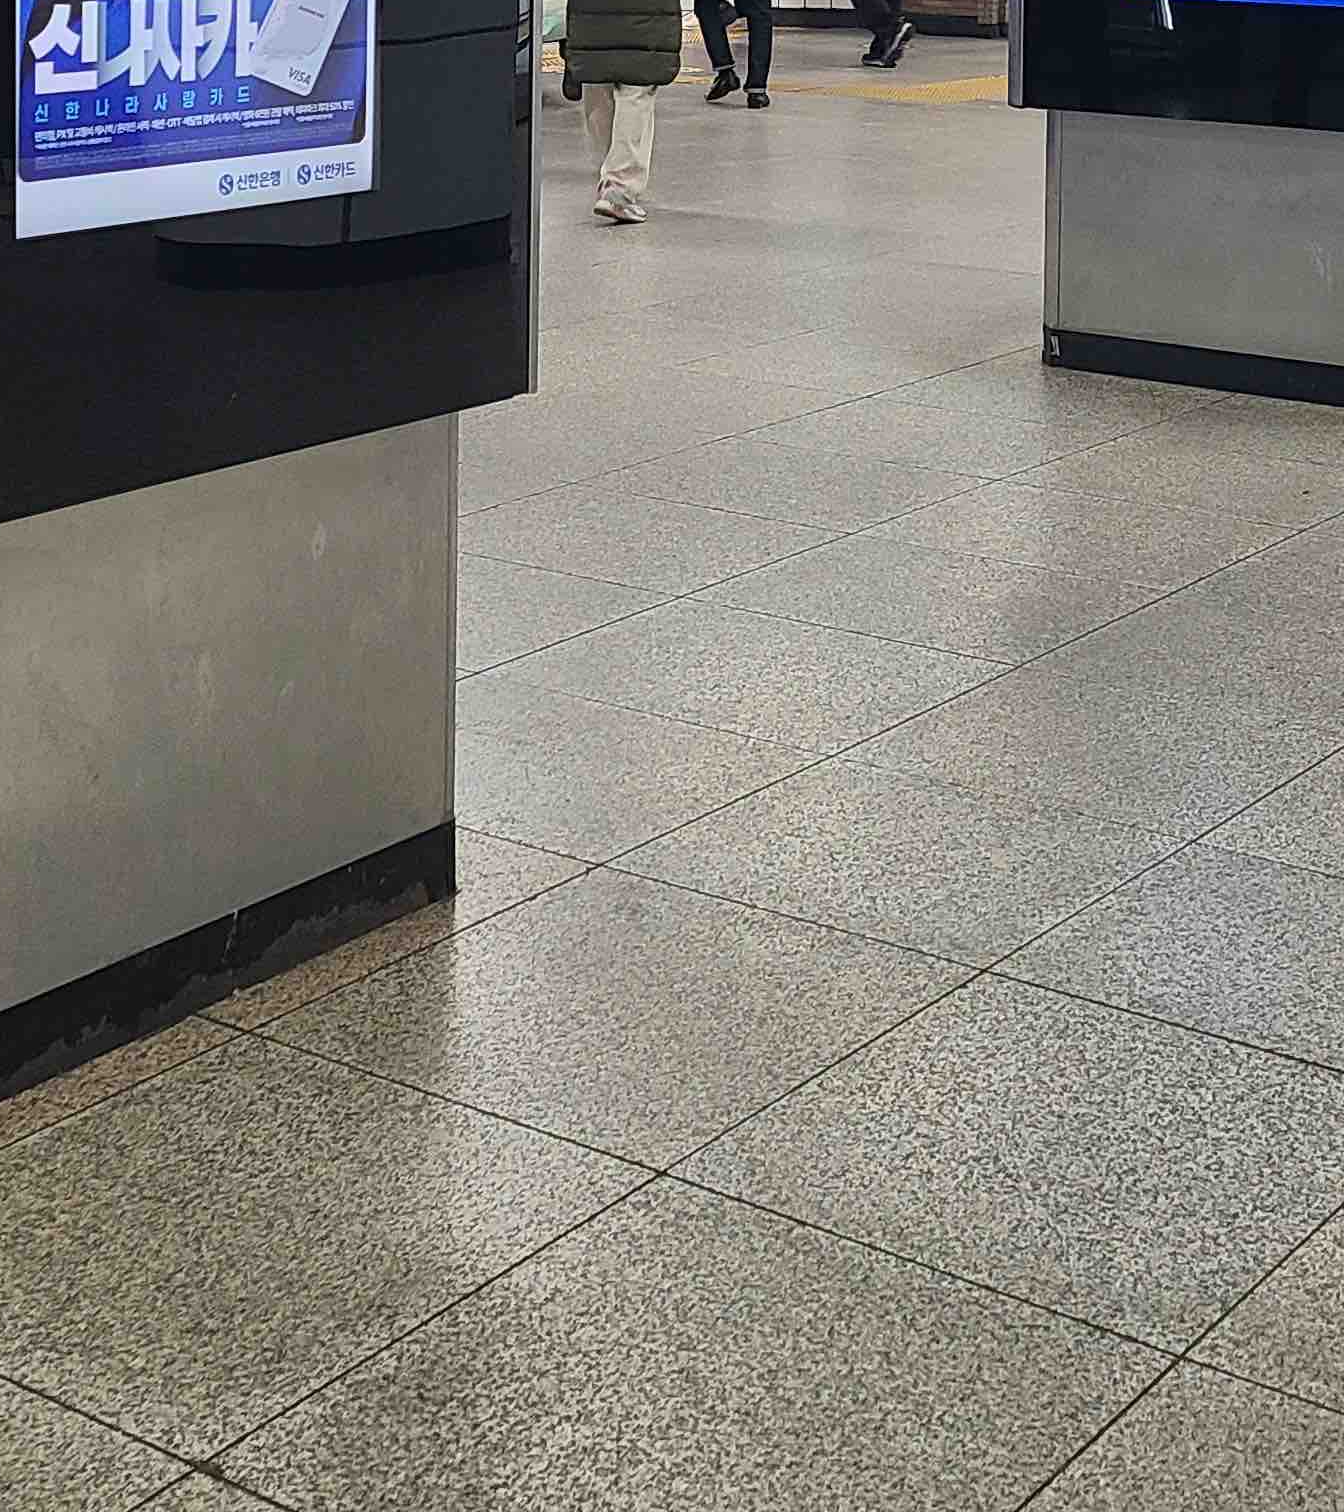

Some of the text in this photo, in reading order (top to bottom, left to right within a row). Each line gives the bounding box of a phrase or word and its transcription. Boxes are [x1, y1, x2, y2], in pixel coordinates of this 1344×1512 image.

[288, 66, 312, 85] VISA
[237, 161, 356, 192] 신한은행 신한카드
